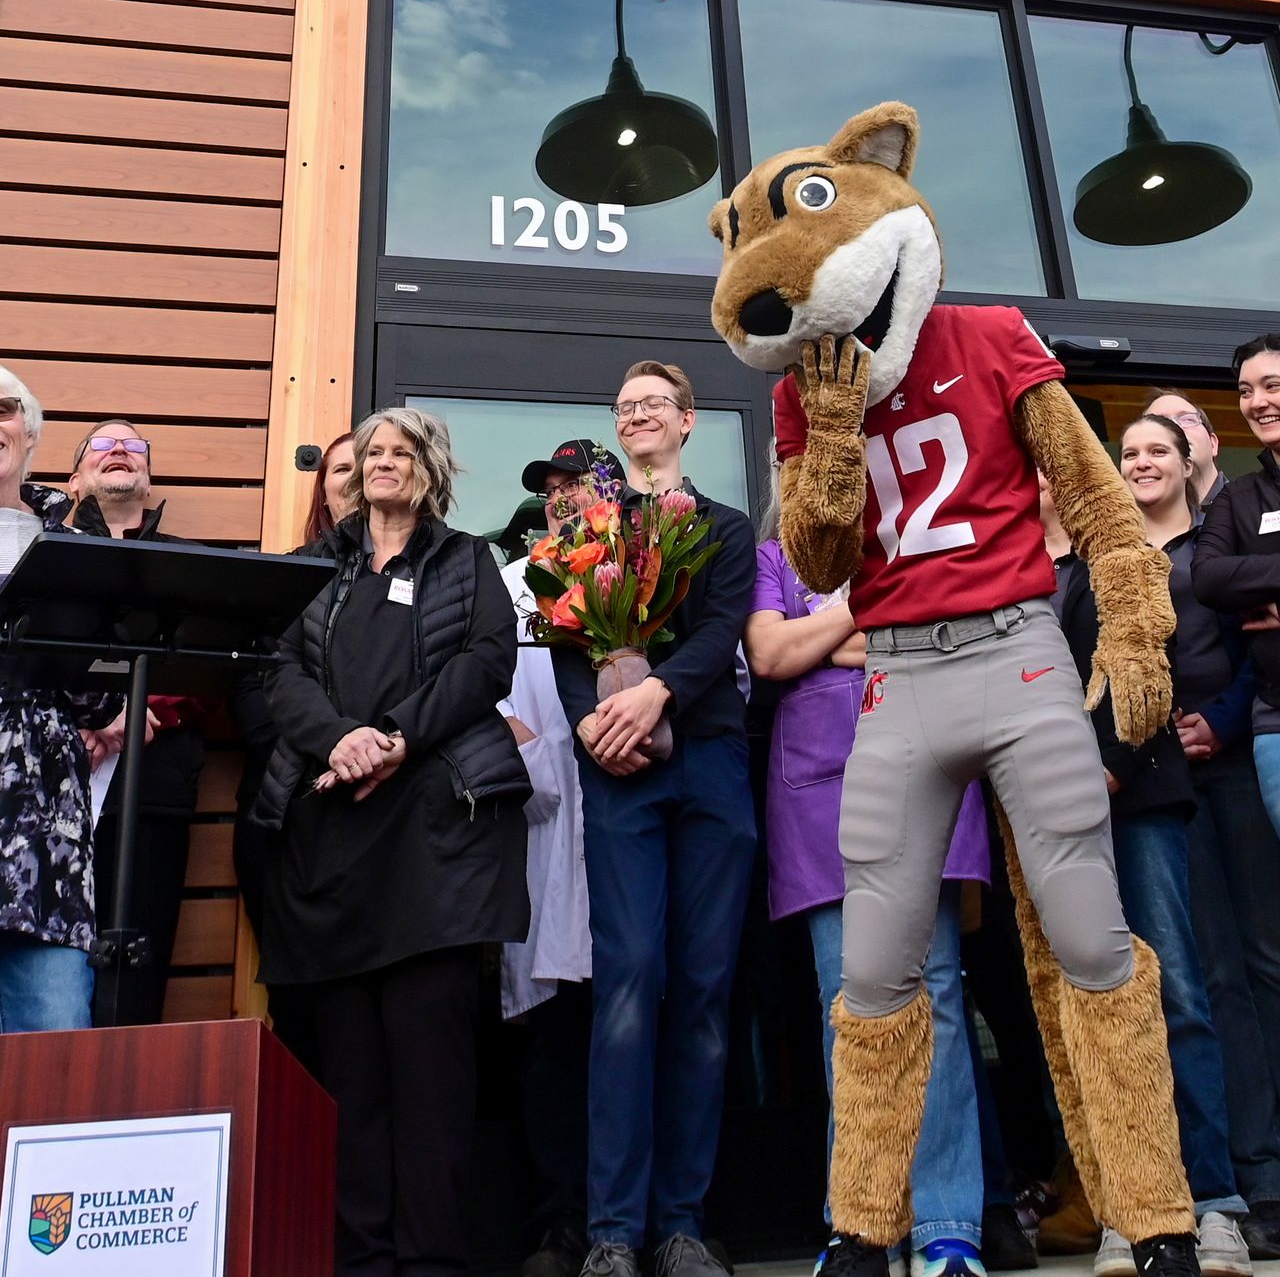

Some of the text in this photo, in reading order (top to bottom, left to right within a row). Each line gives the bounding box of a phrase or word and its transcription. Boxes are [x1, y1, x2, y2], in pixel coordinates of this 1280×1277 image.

[491, 195, 629, 253] 1205
[865, 412, 976, 566] 12
[79, 1187, 175, 1209] PULLMAN
[78, 1201, 199, 1229] CHAMBER of
[76, 1226, 188, 1250] COMMERCE
